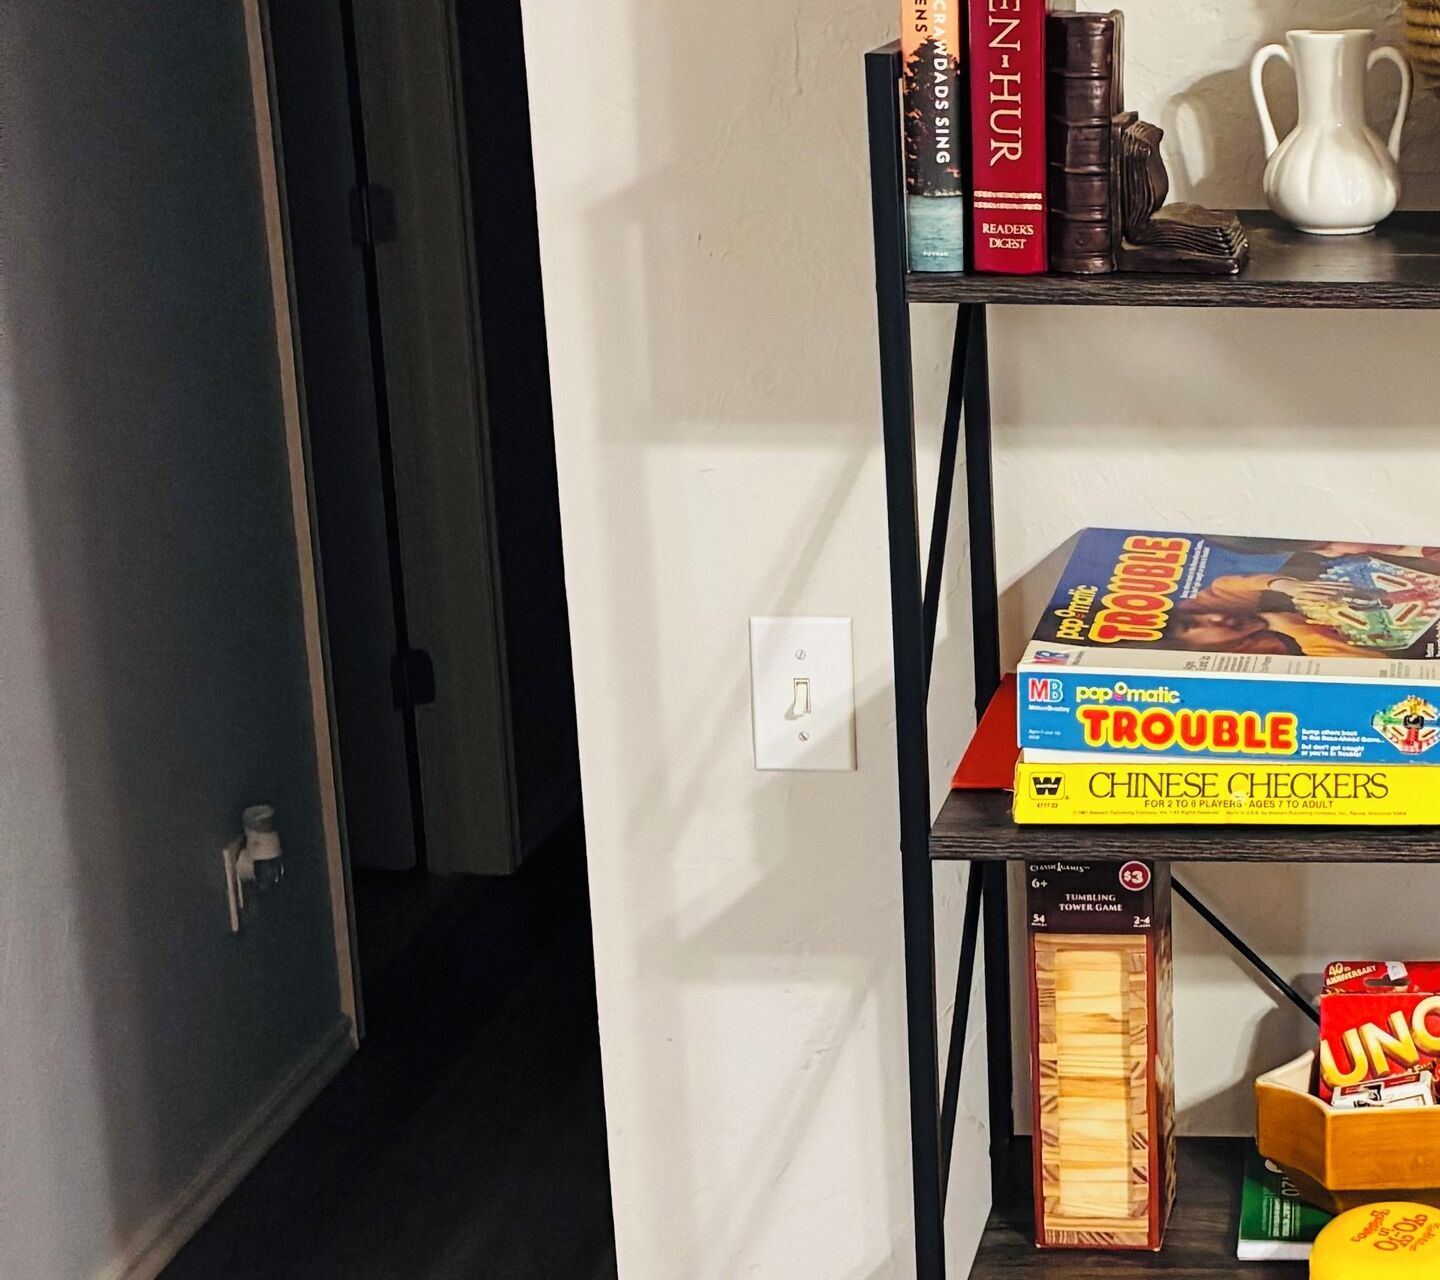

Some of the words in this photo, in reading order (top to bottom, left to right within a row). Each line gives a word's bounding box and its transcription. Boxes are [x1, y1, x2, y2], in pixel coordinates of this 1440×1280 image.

[932, 0, 950, 110] CRAWDADS
[935, 117, 951, 164] SING
[982, 223, 1034, 235] READER'S
[989, 237, 1026, 249] DIGEST
[1088, 535, 1191, 643] TROUBLE
[1028, 677, 1064, 703] MB
[1076, 704, 1298, 756] TROUBLE
[1088, 771, 1220, 799] CHINESE
[1227, 772, 1389, 800] CHECKERS
[1144, 799, 1165, 808] FOR
[1167, 800, 1173, 808] 2
[1176, 800, 1189, 808] TO
[1199, 800, 1243, 809] PLAYERS
[1249, 800, 1275, 809] AGES
[1278, 800, 1283, 808] 7
[1287, 800, 1299, 809] TO
[1302, 800, 1334, 809] ADULT
[1031, 878, 1048, 888] 6+
[1123, 870, 1144, 884] $3
[1065, 893, 1116, 901] TUMBLING
[1059, 903, 1093, 911] TOWER
[1095, 903, 1123, 911] GAME
[1033, 913, 1046, 923] 54
[1133, 915, 1151, 924] 2-4
[1326, 964, 1377, 986] ANNIVERSARY
